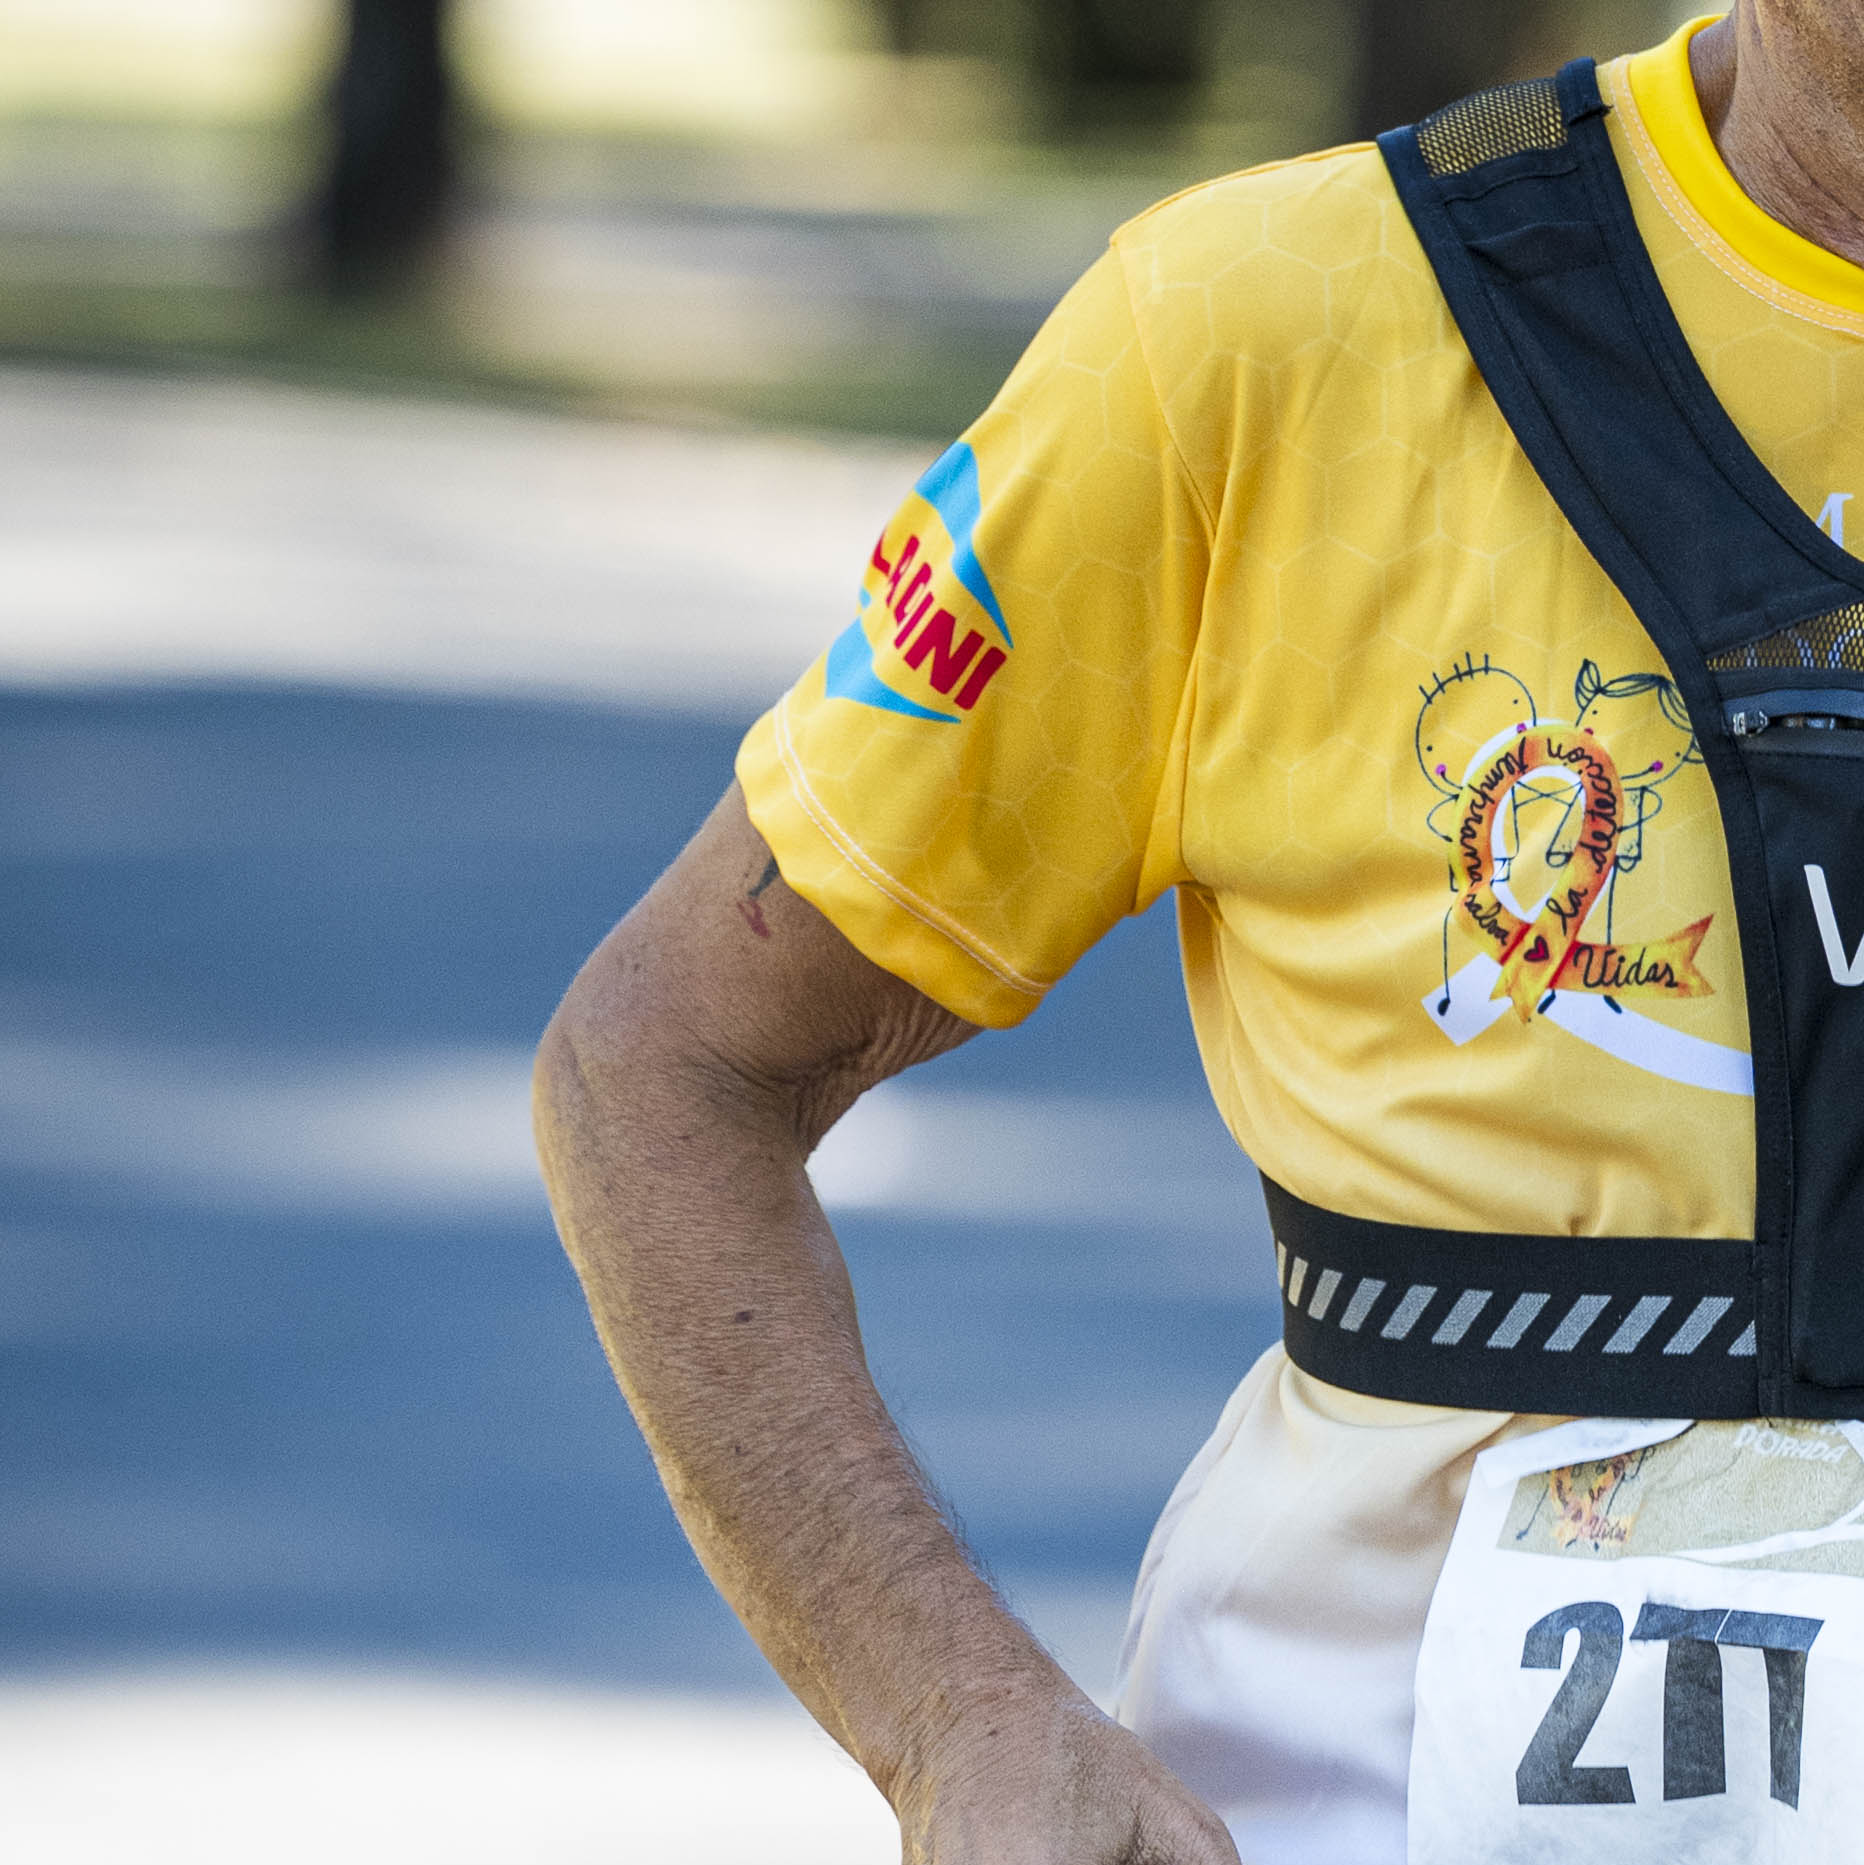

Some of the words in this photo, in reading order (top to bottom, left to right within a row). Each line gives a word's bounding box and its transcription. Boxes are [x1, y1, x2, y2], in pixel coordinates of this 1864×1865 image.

[1460, 736, 1528, 887] temprana
[1573, 944, 1678, 988] Vidas
[1515, 1601, 1826, 1812] 277
